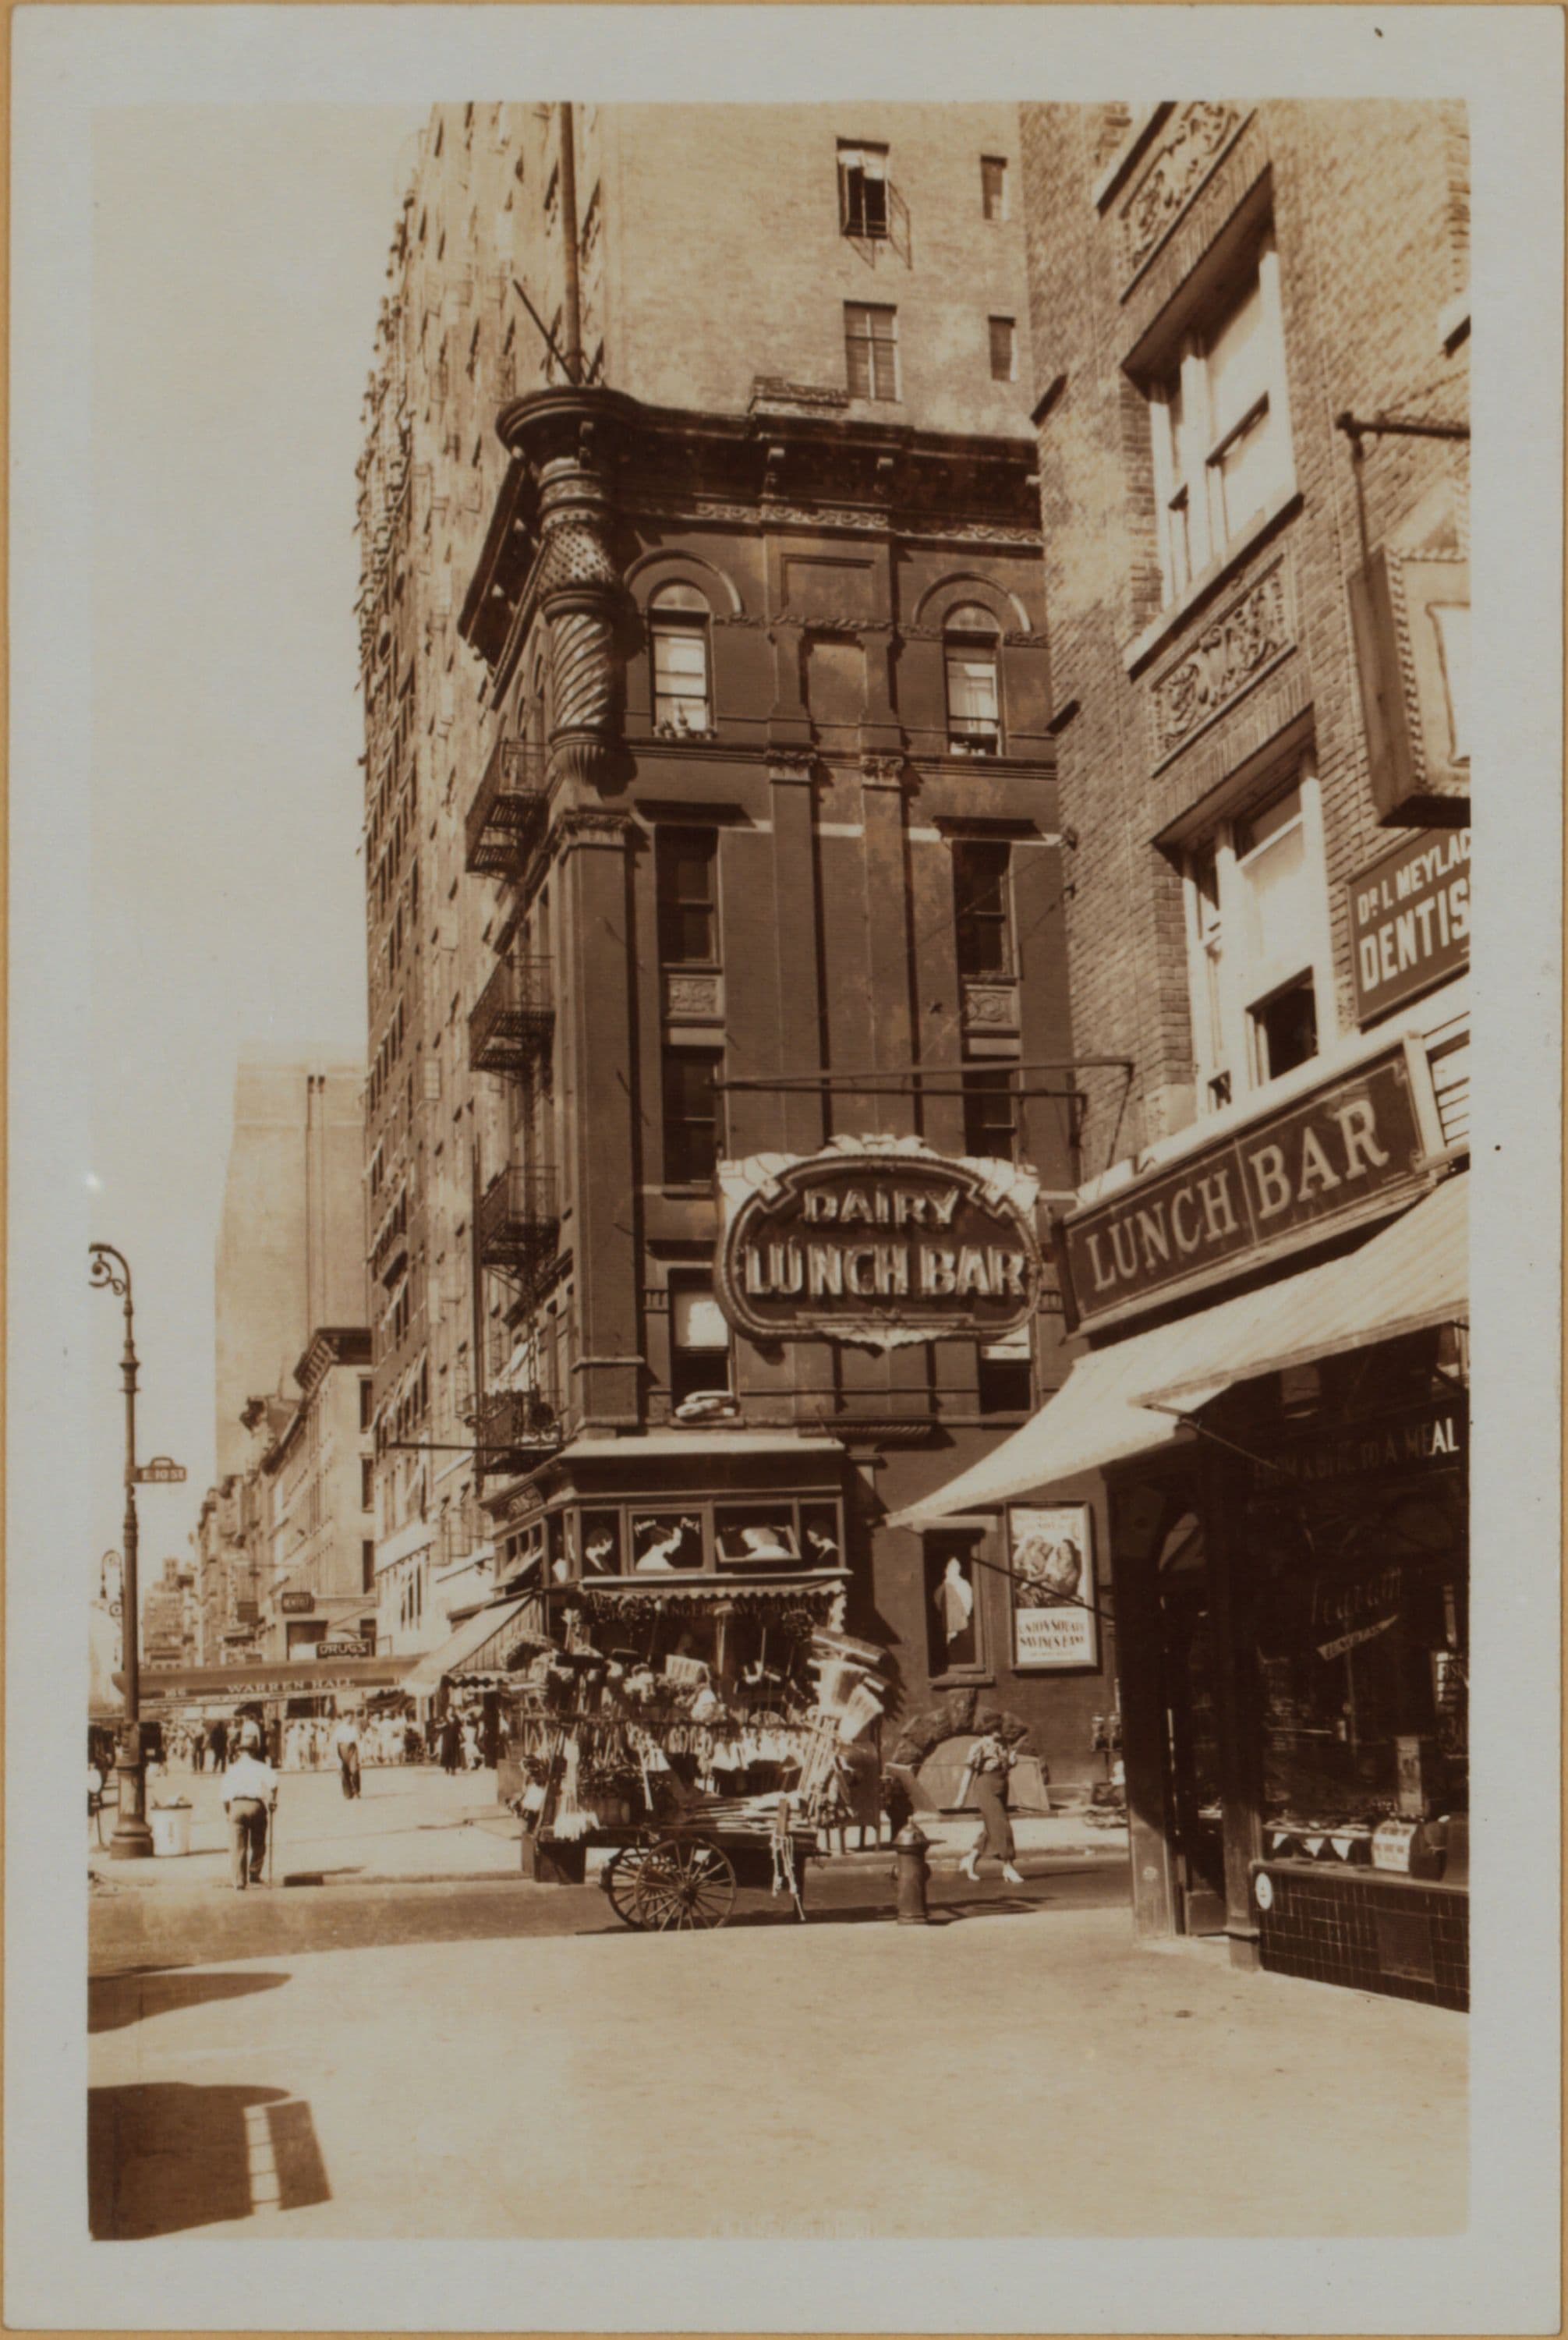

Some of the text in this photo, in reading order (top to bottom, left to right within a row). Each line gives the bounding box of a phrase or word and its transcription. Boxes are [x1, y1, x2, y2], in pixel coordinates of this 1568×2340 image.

[803, 1187, 959, 1224] DAIRY
[1085, 1099, 1390, 1292] LUNCH BAR
[745, 1243, 1026, 1296] LUNCH BAR
[319, 1643, 366, 1655] DRUGS
[227, 1677, 356, 1694] WARREN HALL
